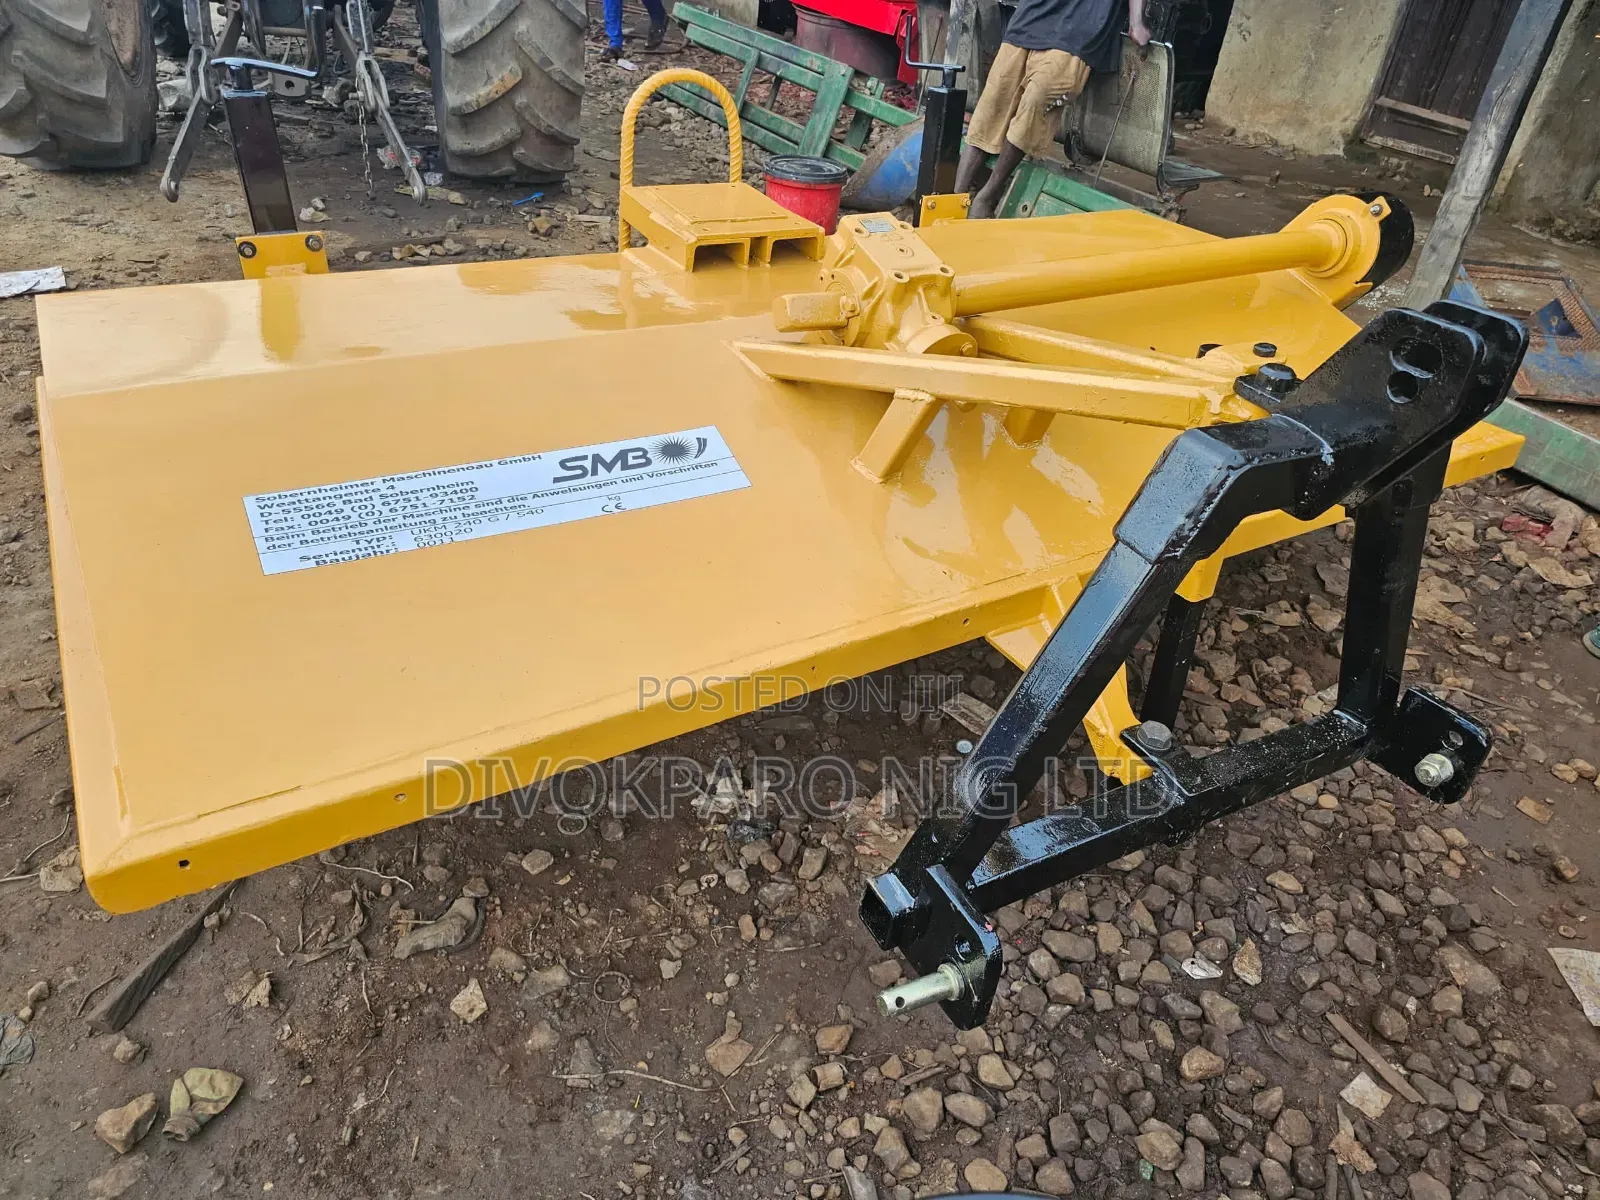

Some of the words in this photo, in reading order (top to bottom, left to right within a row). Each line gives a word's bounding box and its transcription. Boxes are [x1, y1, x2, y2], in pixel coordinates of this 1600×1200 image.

[255, 480, 377, 502] Sobernheimer
[498, 454, 542, 466] GmbH
[553, 446, 652, 484] SMB
[260, 501, 336, 518] D-55566
[342, 495, 374, 506] Bad
[379, 480, 475, 500] Sobernheim
[261, 516, 294, 526] Tel:
[301, 508, 344, 520] 0049
[351, 503, 375, 513] (0)
[381, 486, 479, 507] 6751-93400
[264, 531, 305, 543] Beim
[311, 521, 368, 536] Betrieb
[373, 516, 398, 525] der
[402, 504, 470, 520] Maschine
[474, 499, 503, 508] sind
[507, 494, 528, 504] die
[621, 474, 644, 484] und
[646, 461, 718, 479] Vorschriften
[264, 523, 302, 533] Fax:
[308, 515, 351, 527] 0049
[358, 509, 383, 519] (0)
[389, 494, 477, 514] 6751-7152
[607, 494, 621, 502] kg
[266, 541, 295, 551] der
[299, 519, 437, 546] Betriebsanleitung
[441, 514, 458, 522] zu
[462, 503, 531, 518] beachten.
[299, 542, 396, 562] Seriennr.:
[413, 527, 473, 542] 630020
[351, 535, 394, 546] Typ:
[410, 525, 447, 536] UKM
[454, 518, 482, 528] 240
[517, 508, 544, 518] 540
[315, 547, 399, 566] Baujahr:
